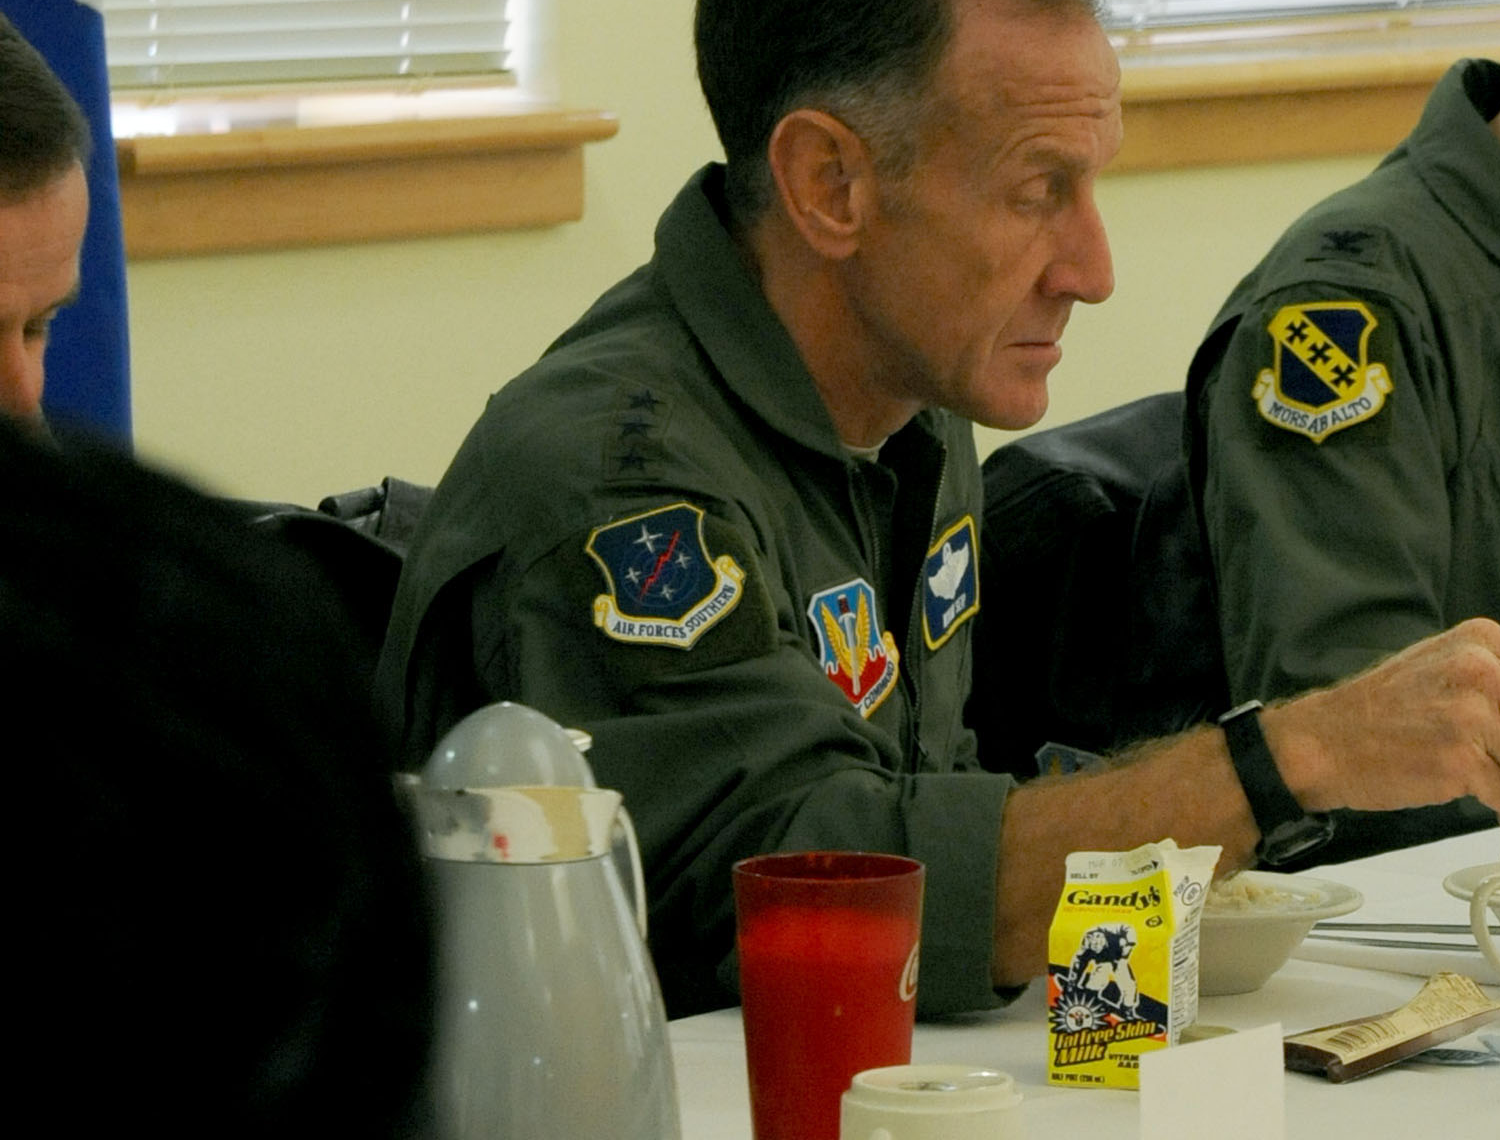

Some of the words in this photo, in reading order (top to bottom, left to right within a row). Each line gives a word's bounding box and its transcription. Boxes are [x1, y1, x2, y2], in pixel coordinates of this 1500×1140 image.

[1268, 401, 1309, 429] MORS
[1307, 415, 1328, 434] AB
[1331, 397, 1372, 426] ALTO
[612, 621, 636, 636] AIR
[638, 624, 688, 639] FORCES
[684, 583, 736, 633] SOUTHERN
[1067, 885, 1161, 911] Gandy's
[1057, 1043, 1106, 1065] Milk
